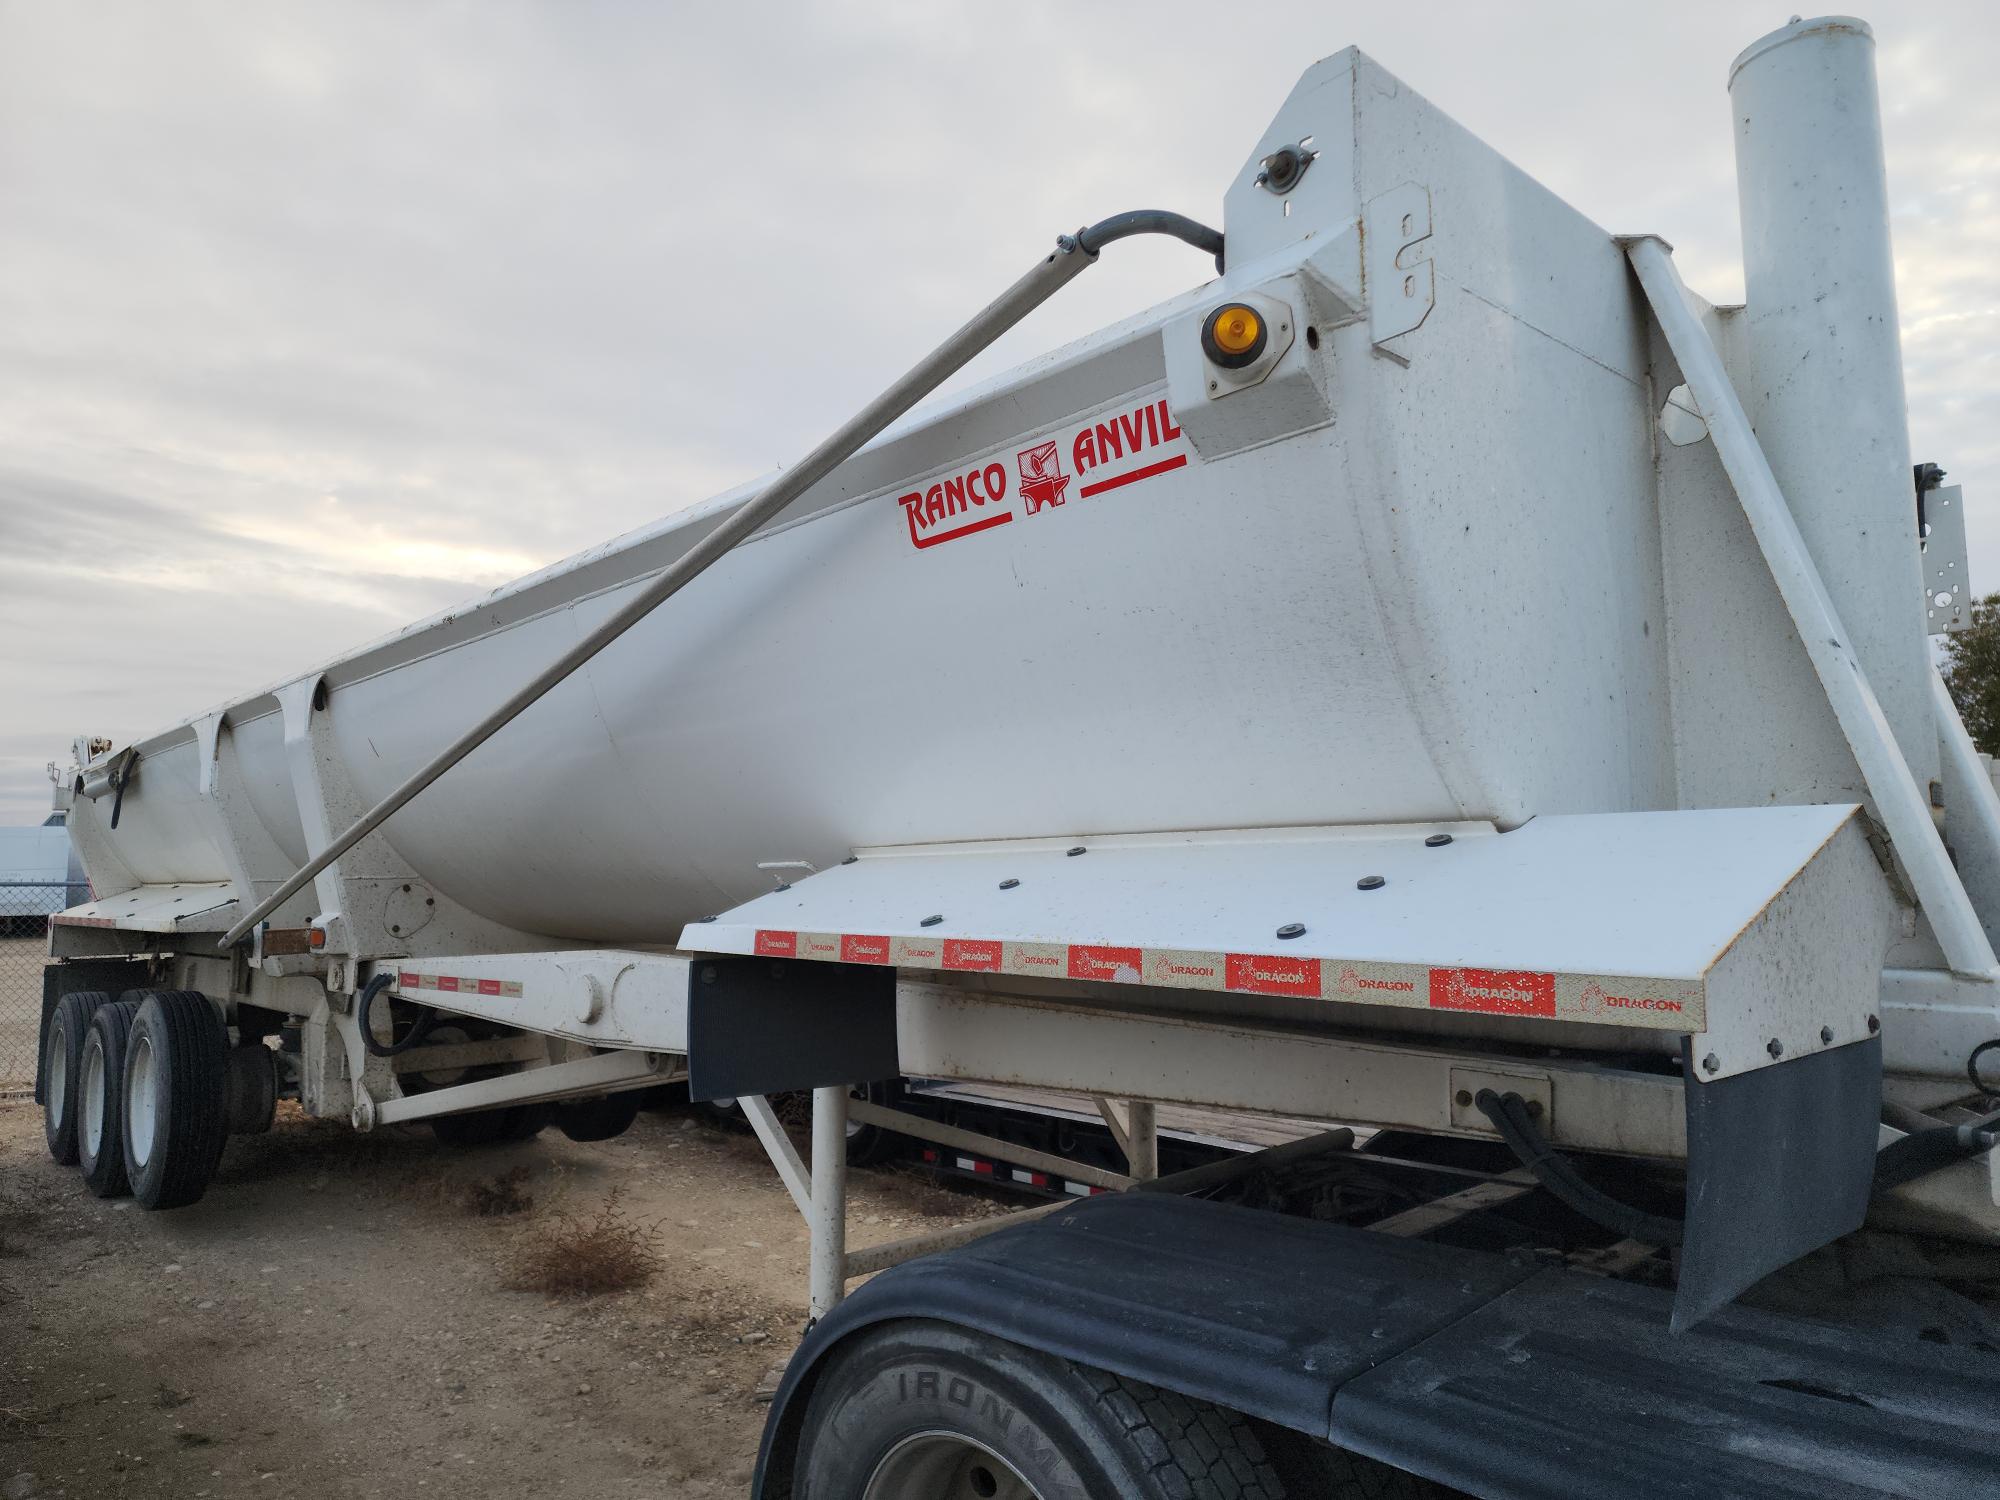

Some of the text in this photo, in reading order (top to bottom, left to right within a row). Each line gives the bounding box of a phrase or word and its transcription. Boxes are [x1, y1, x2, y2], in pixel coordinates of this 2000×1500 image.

[898, 400, 1181, 542] RANCO ANVIL
[907, 949, 936, 958] DRAGON
[961, 952, 992, 962] DRAGON
[1024, 956, 1059, 966] DRAGON
[1170, 965, 1214, 976] DRAGON
[1255, 972, 1305, 984] DRAGON
[1358, 979, 1414, 992] DRAGON
[1470, 987, 1534, 1002] DRAGON
[1606, 996, 1682, 1012] DRAGON
[897, 1371, 1080, 1492] IRONM
